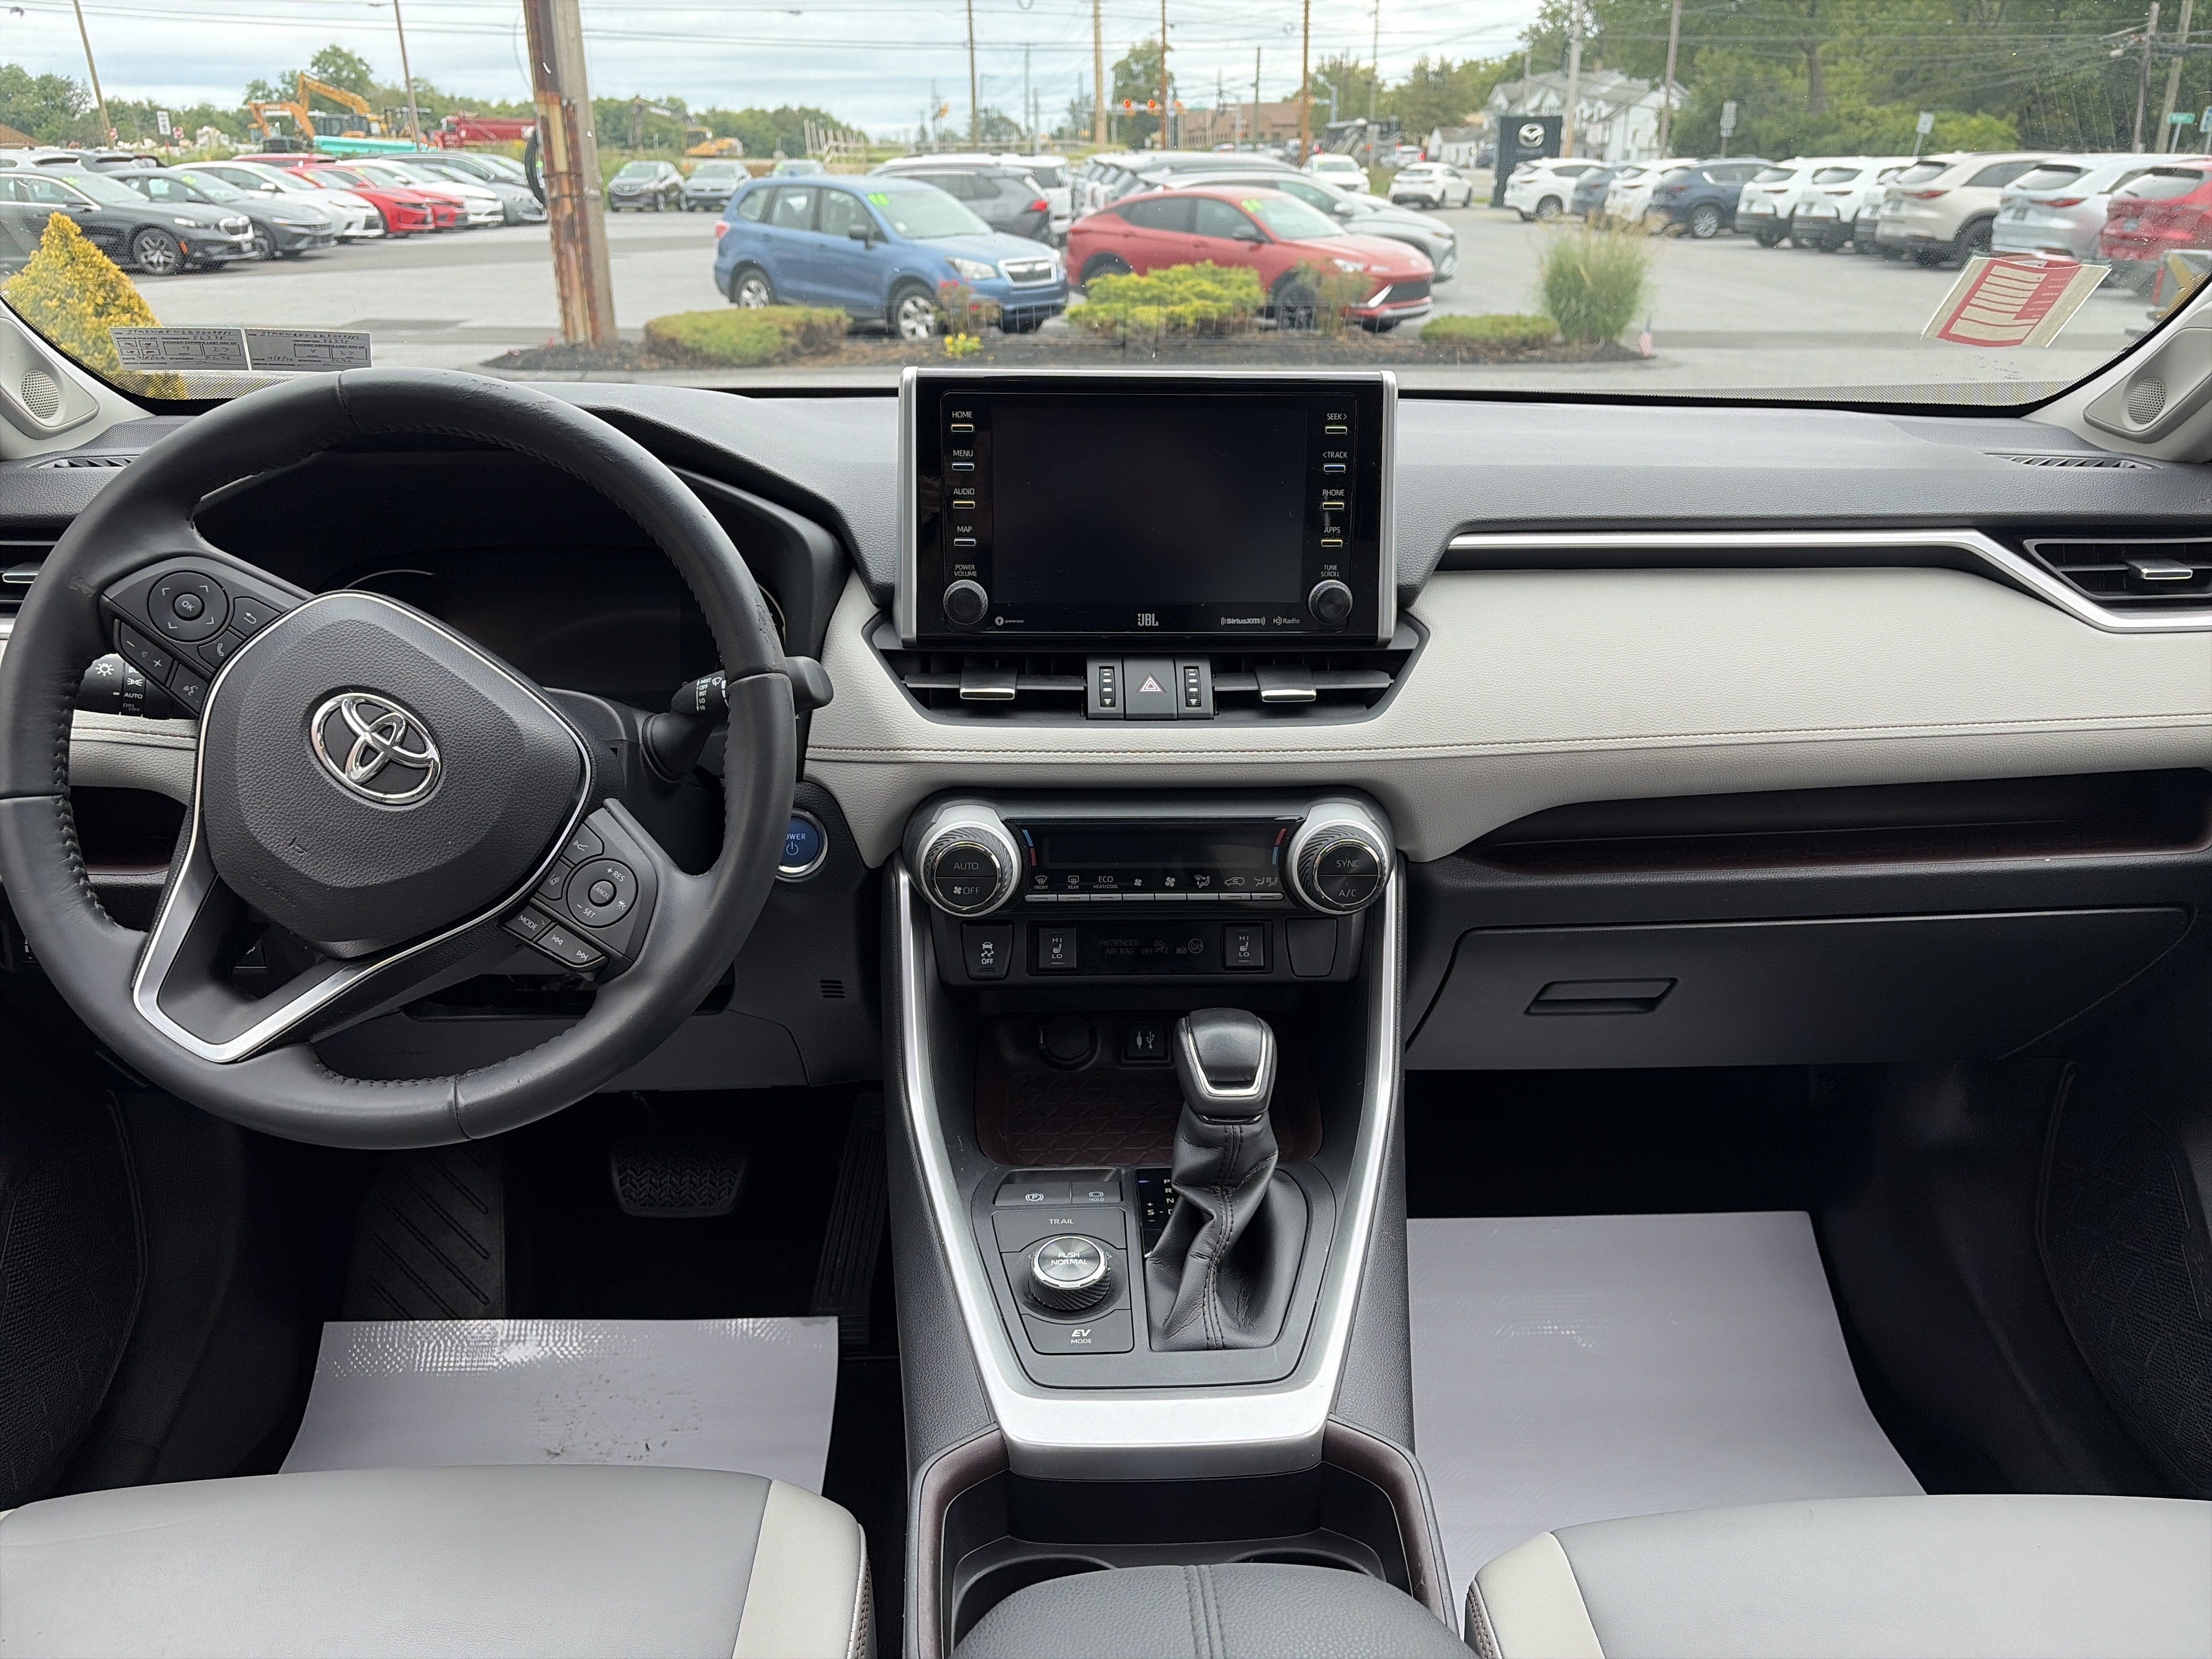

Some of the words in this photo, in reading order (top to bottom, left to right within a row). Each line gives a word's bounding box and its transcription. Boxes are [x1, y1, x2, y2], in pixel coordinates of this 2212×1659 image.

[181, 600, 195, 612] OK
[1137, 613, 1159, 627] JBL
[953, 862, 979, 870] AUTO
[612, 870, 626, 882] RES
[592, 884, 611, 900] CANCEL
[1339, 889, 1357, 898] A/C
[583, 907, 596, 918] SET
[518, 915, 538, 931] MODE
[1071, 1329, 1092, 1338] EV
